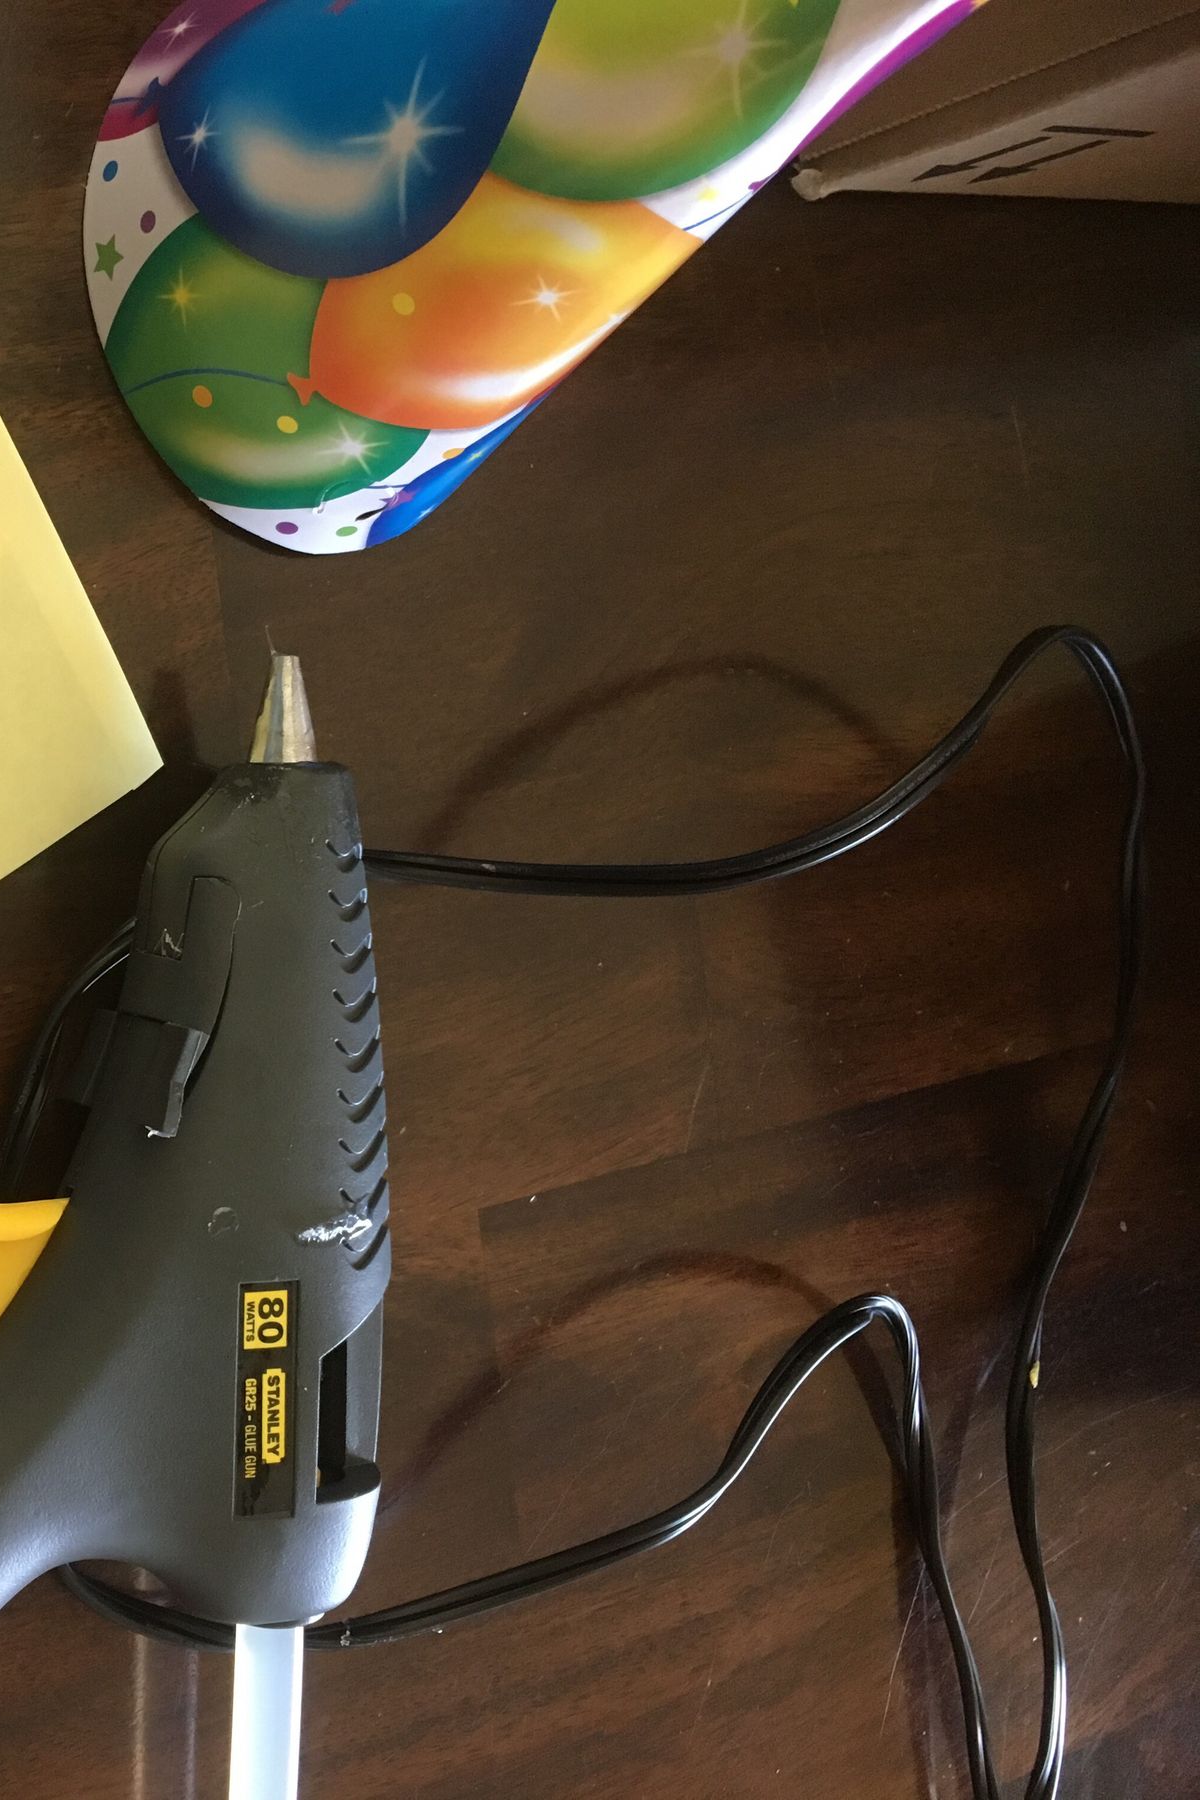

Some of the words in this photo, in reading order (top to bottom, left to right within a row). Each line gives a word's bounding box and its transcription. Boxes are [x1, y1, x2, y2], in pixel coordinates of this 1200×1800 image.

[245, 1301, 255, 1342] WATTS
[258, 1297, 284, 1344] 80
[266, 1375, 281, 1456] STANLEY
[244, 1424, 257, 1453] GLUE
[244, 1456, 257, 1479] GUN
